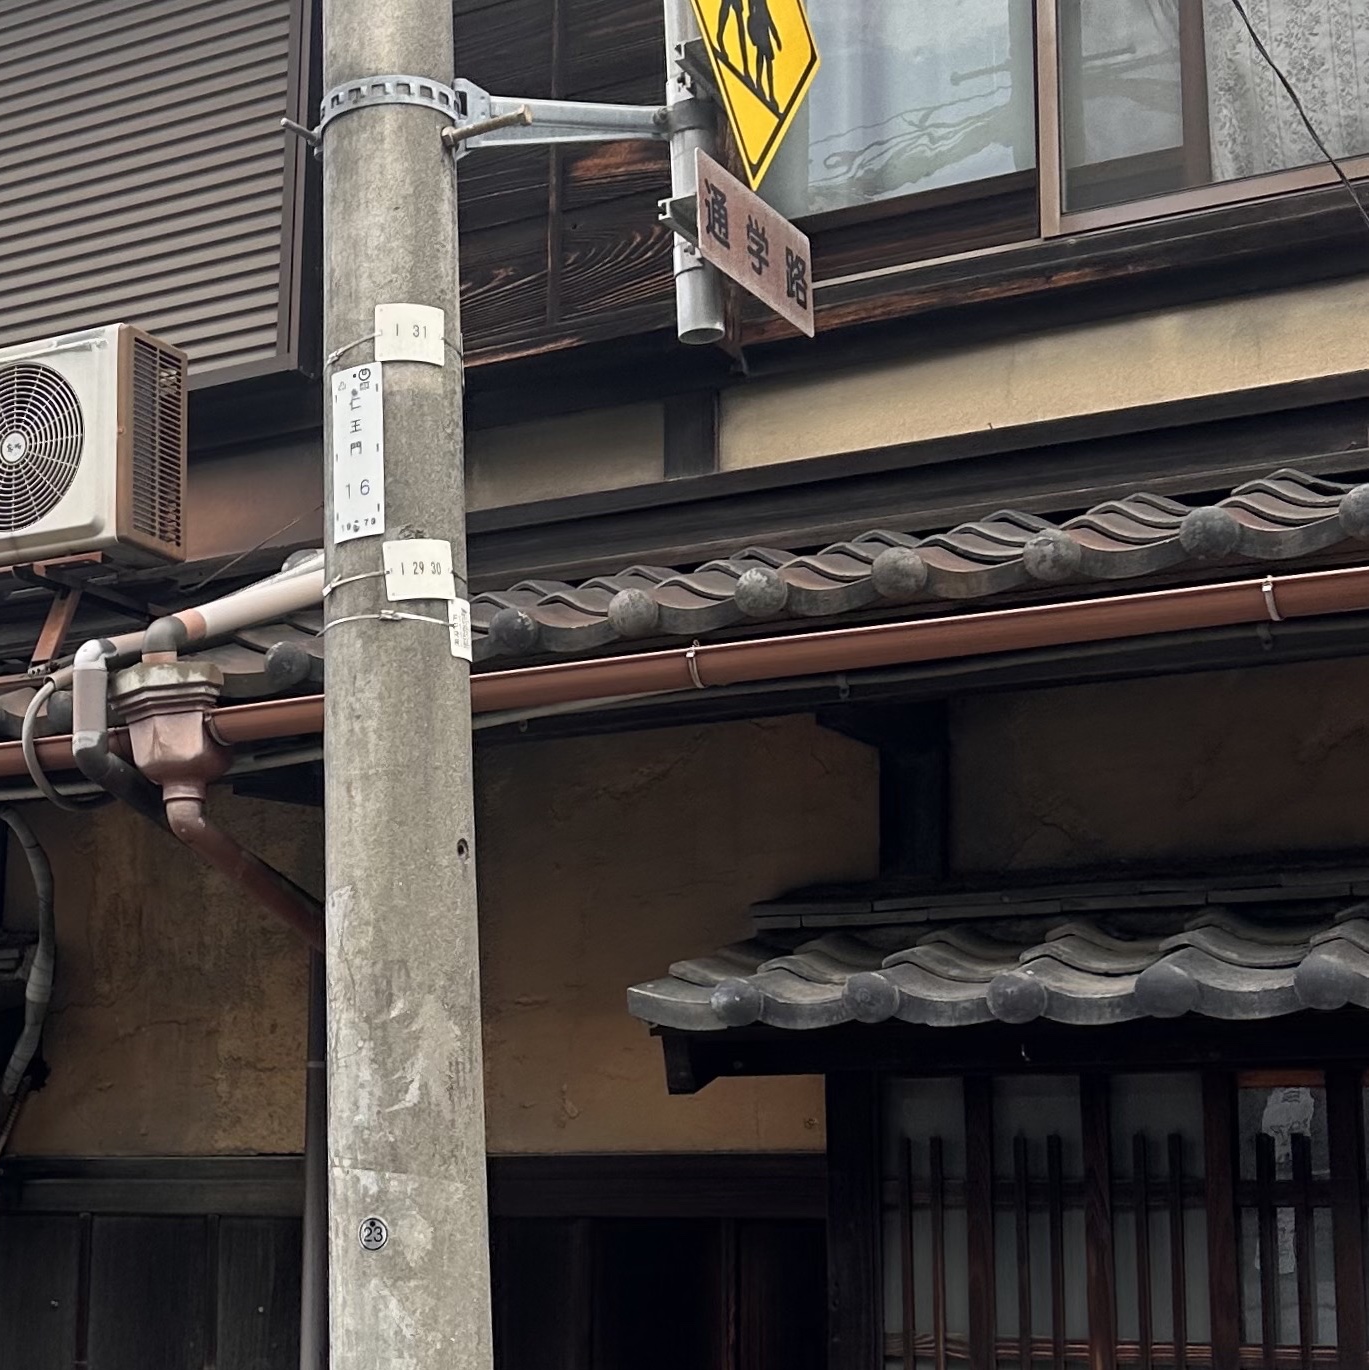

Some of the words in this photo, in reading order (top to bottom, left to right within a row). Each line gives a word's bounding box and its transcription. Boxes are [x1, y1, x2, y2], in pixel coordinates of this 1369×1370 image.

[704, 178, 807, 310] 通学路
[413, 324, 427, 339] 31
[349, 396, 363, 456] 仁王門
[413, 561, 425, 575] 29
[431, 561, 442, 576] 30
[363, 1226, 383, 1242] 23
